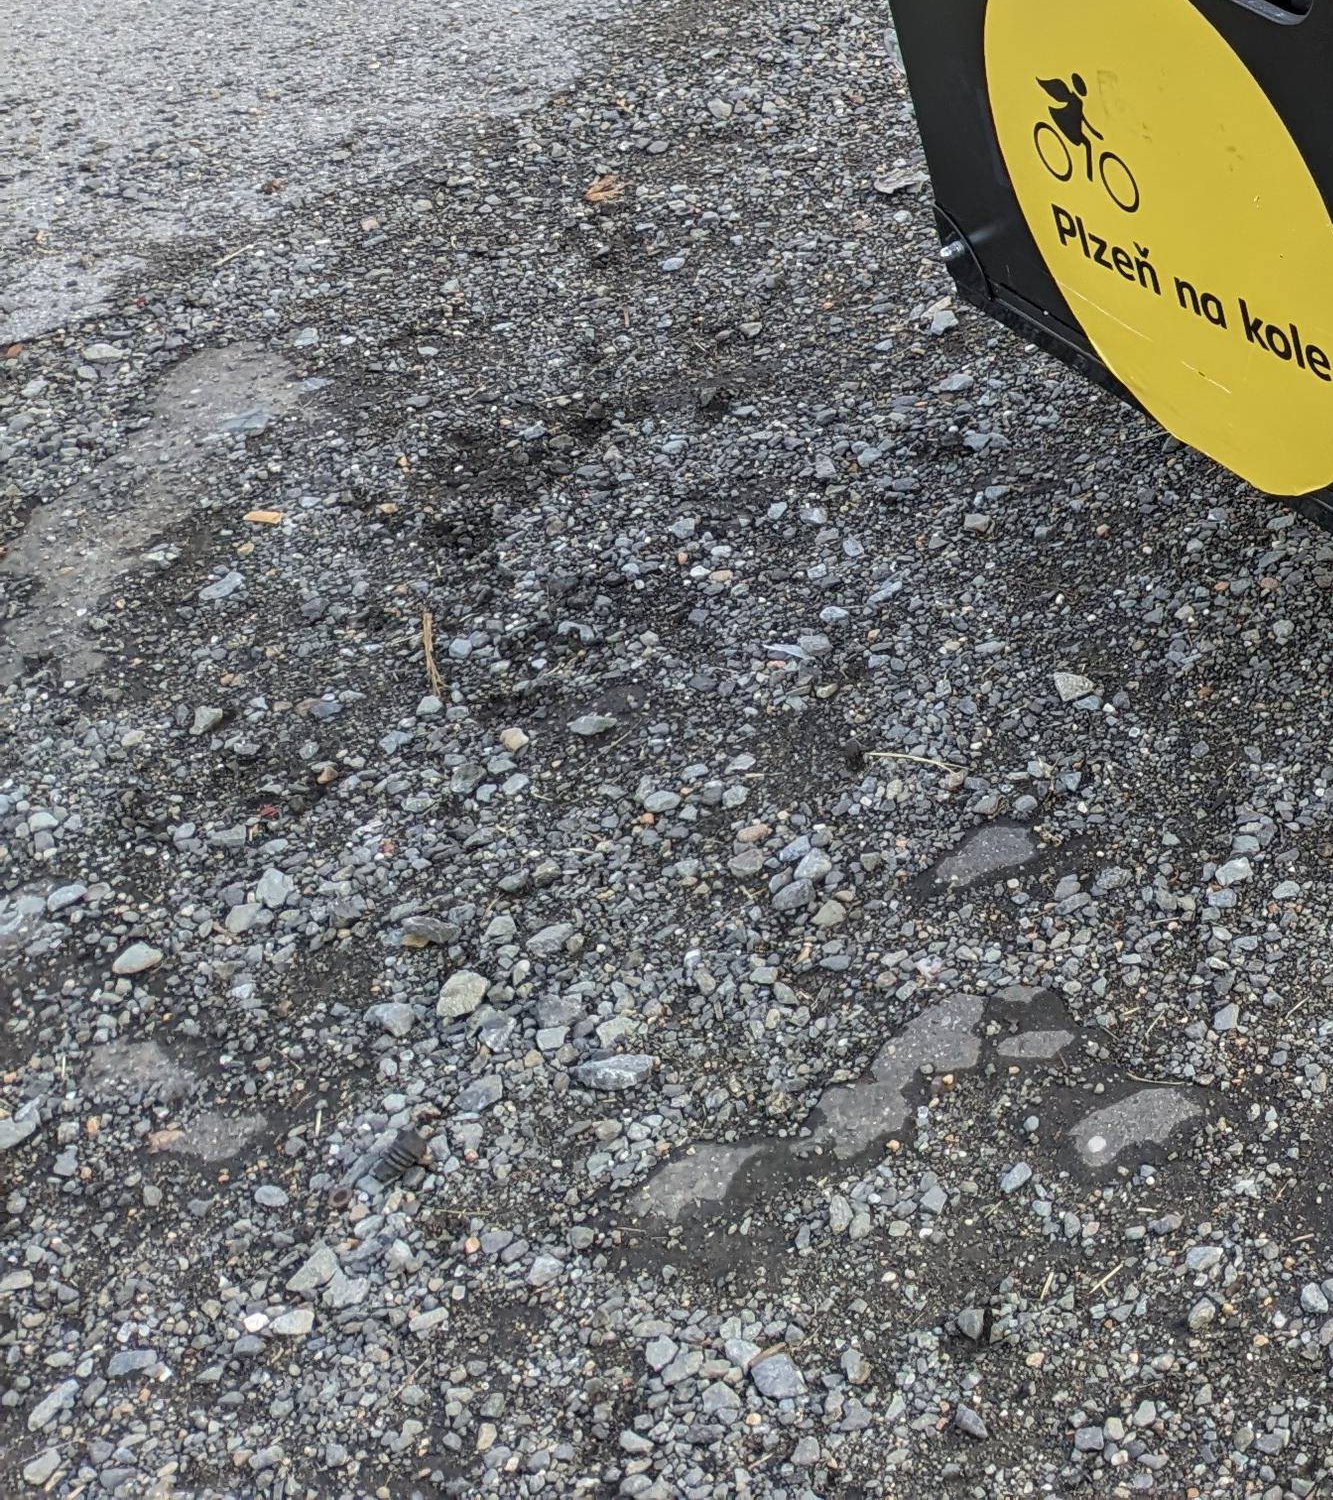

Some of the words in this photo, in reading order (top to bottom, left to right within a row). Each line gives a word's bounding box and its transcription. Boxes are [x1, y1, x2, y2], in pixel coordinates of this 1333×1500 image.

[1050, 202, 1162, 296] Plzeň
[1173, 275, 1228, 330] na
[1237, 297, 1333, 383] kole
